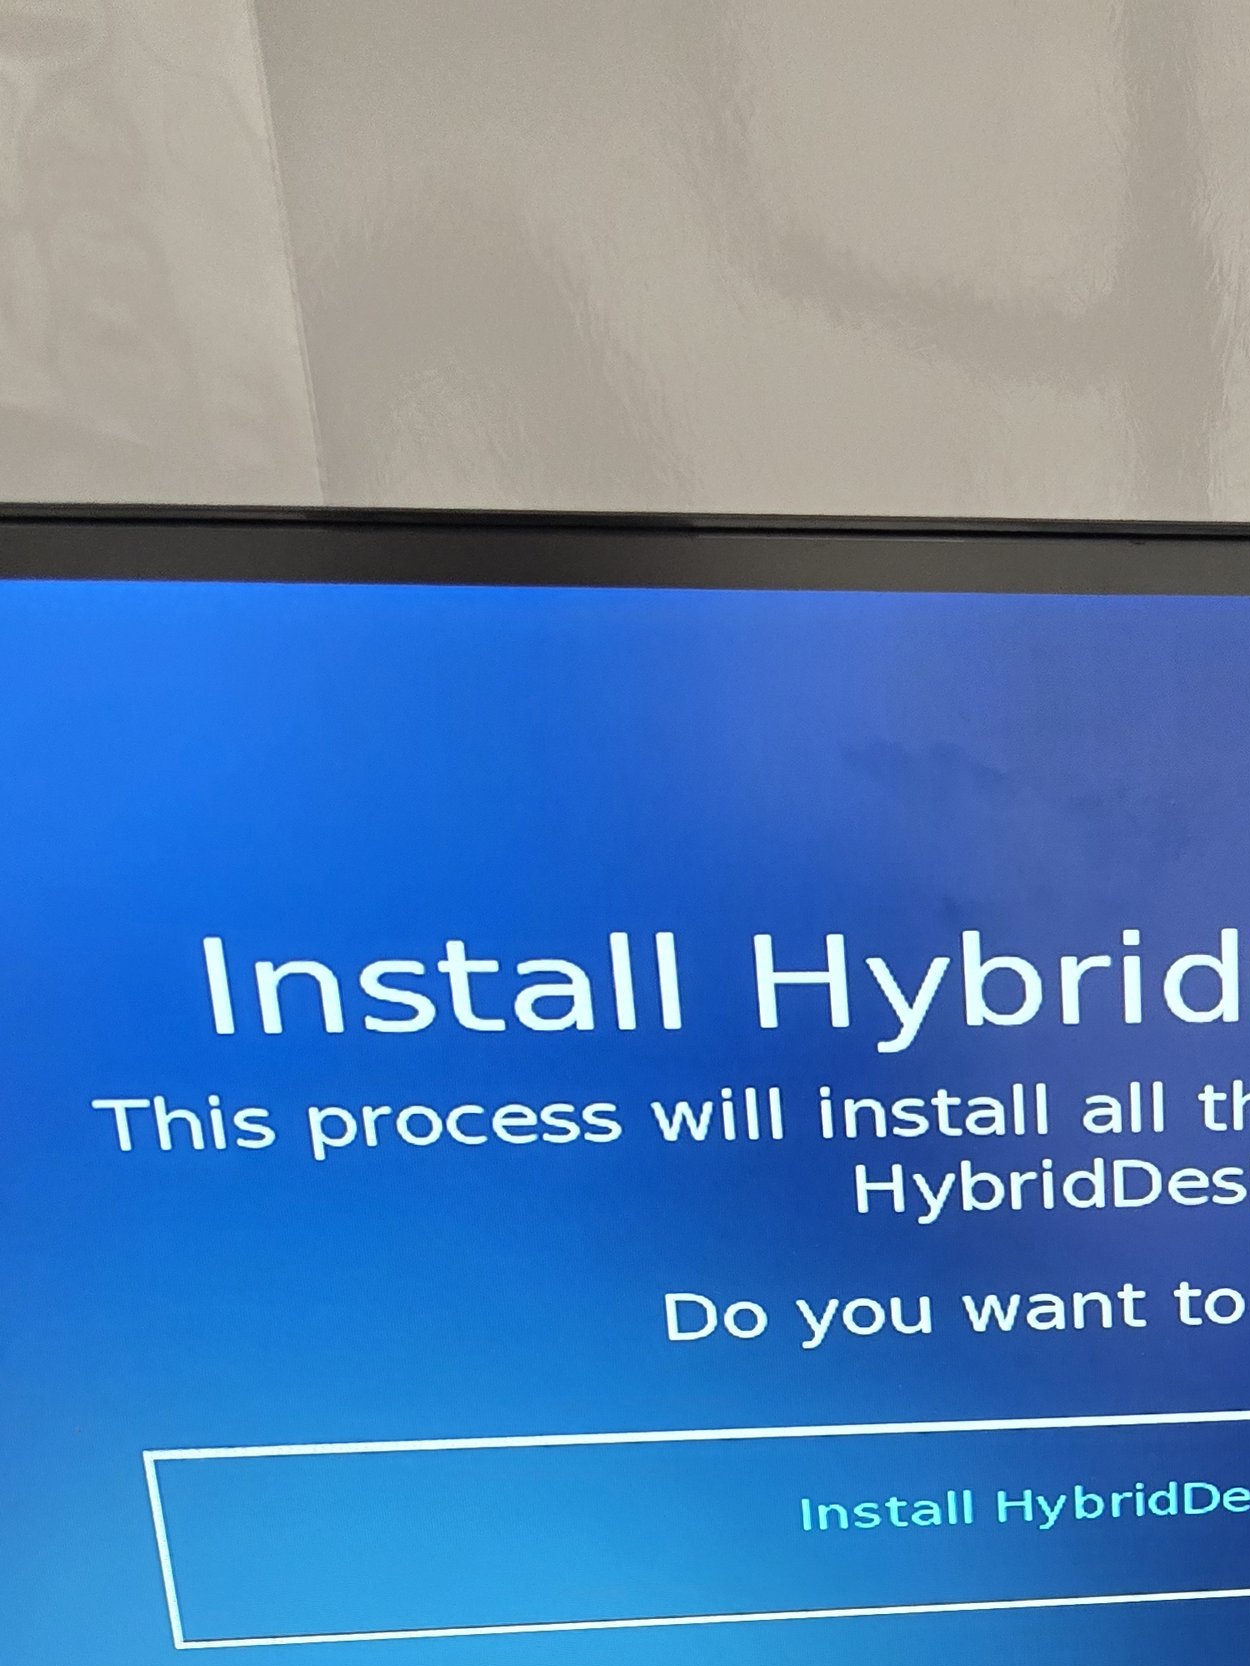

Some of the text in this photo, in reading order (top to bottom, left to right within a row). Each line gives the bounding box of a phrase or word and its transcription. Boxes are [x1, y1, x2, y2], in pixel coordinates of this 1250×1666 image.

[202, 931, 683, 1035] Install
[91, 1094, 276, 1152] This
[308, 1102, 623, 1161] process
[650, 1086, 784, 1142] will
[819, 1082, 1049, 1139] install
[1082, 1080, 1165, 1134] all
[664, 1292, 768, 1341] Do
[795, 1295, 933, 1349] you
[961, 1282, 1148, 1333] want
[1173, 1280, 1246, 1326] to
[801, 1489, 974, 1531] Install
